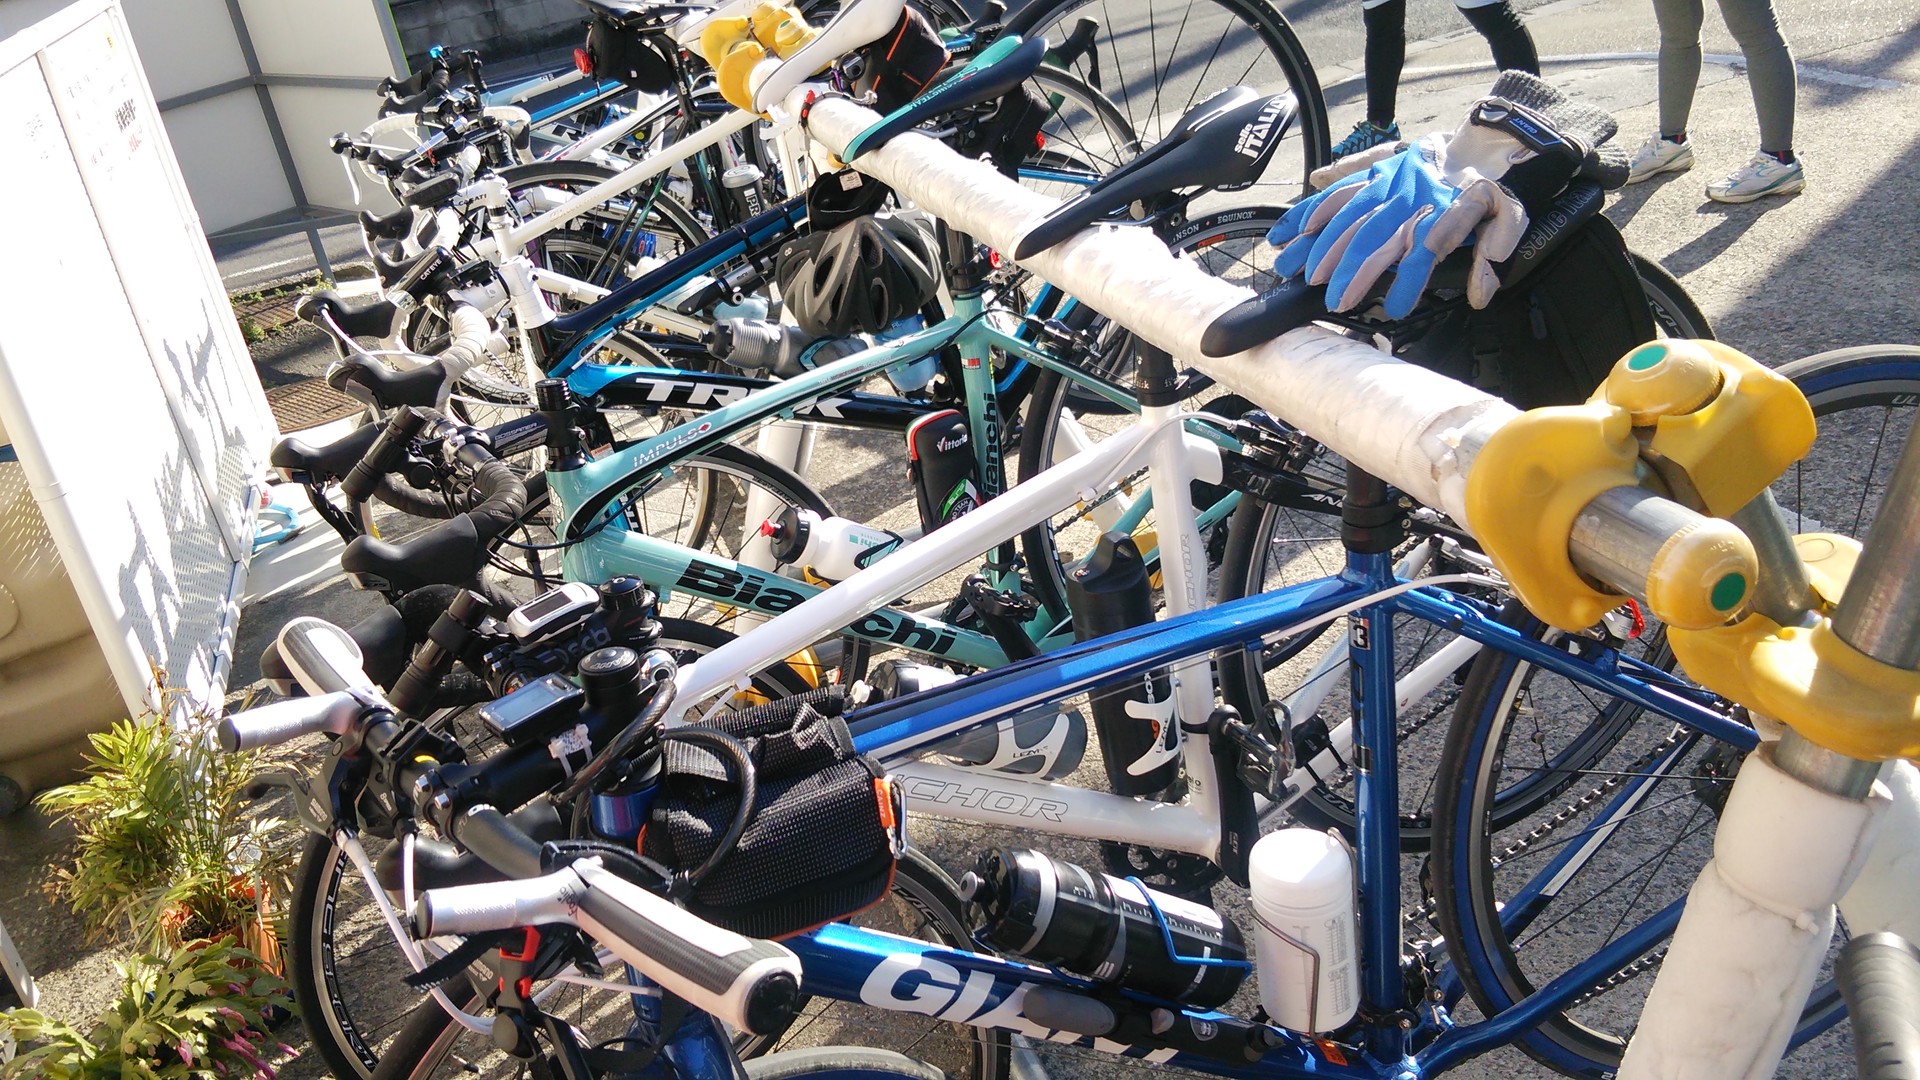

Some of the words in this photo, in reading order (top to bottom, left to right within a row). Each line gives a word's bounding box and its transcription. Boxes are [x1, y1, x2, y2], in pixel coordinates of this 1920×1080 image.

[1234, 123, 1253, 153] selle
[1241, 97, 1286, 158] ITALIA
[1514, 117, 1538, 134] GIANT
[1518, 206, 1568, 259] selle
[420, 259, 442, 280] CATEYE
[635, 377, 853, 418] TRK
[633, 421, 712, 468] IMPULSO
[936, 433, 968, 453] Vittoria
[860, 953, 1180, 1063] GIA
